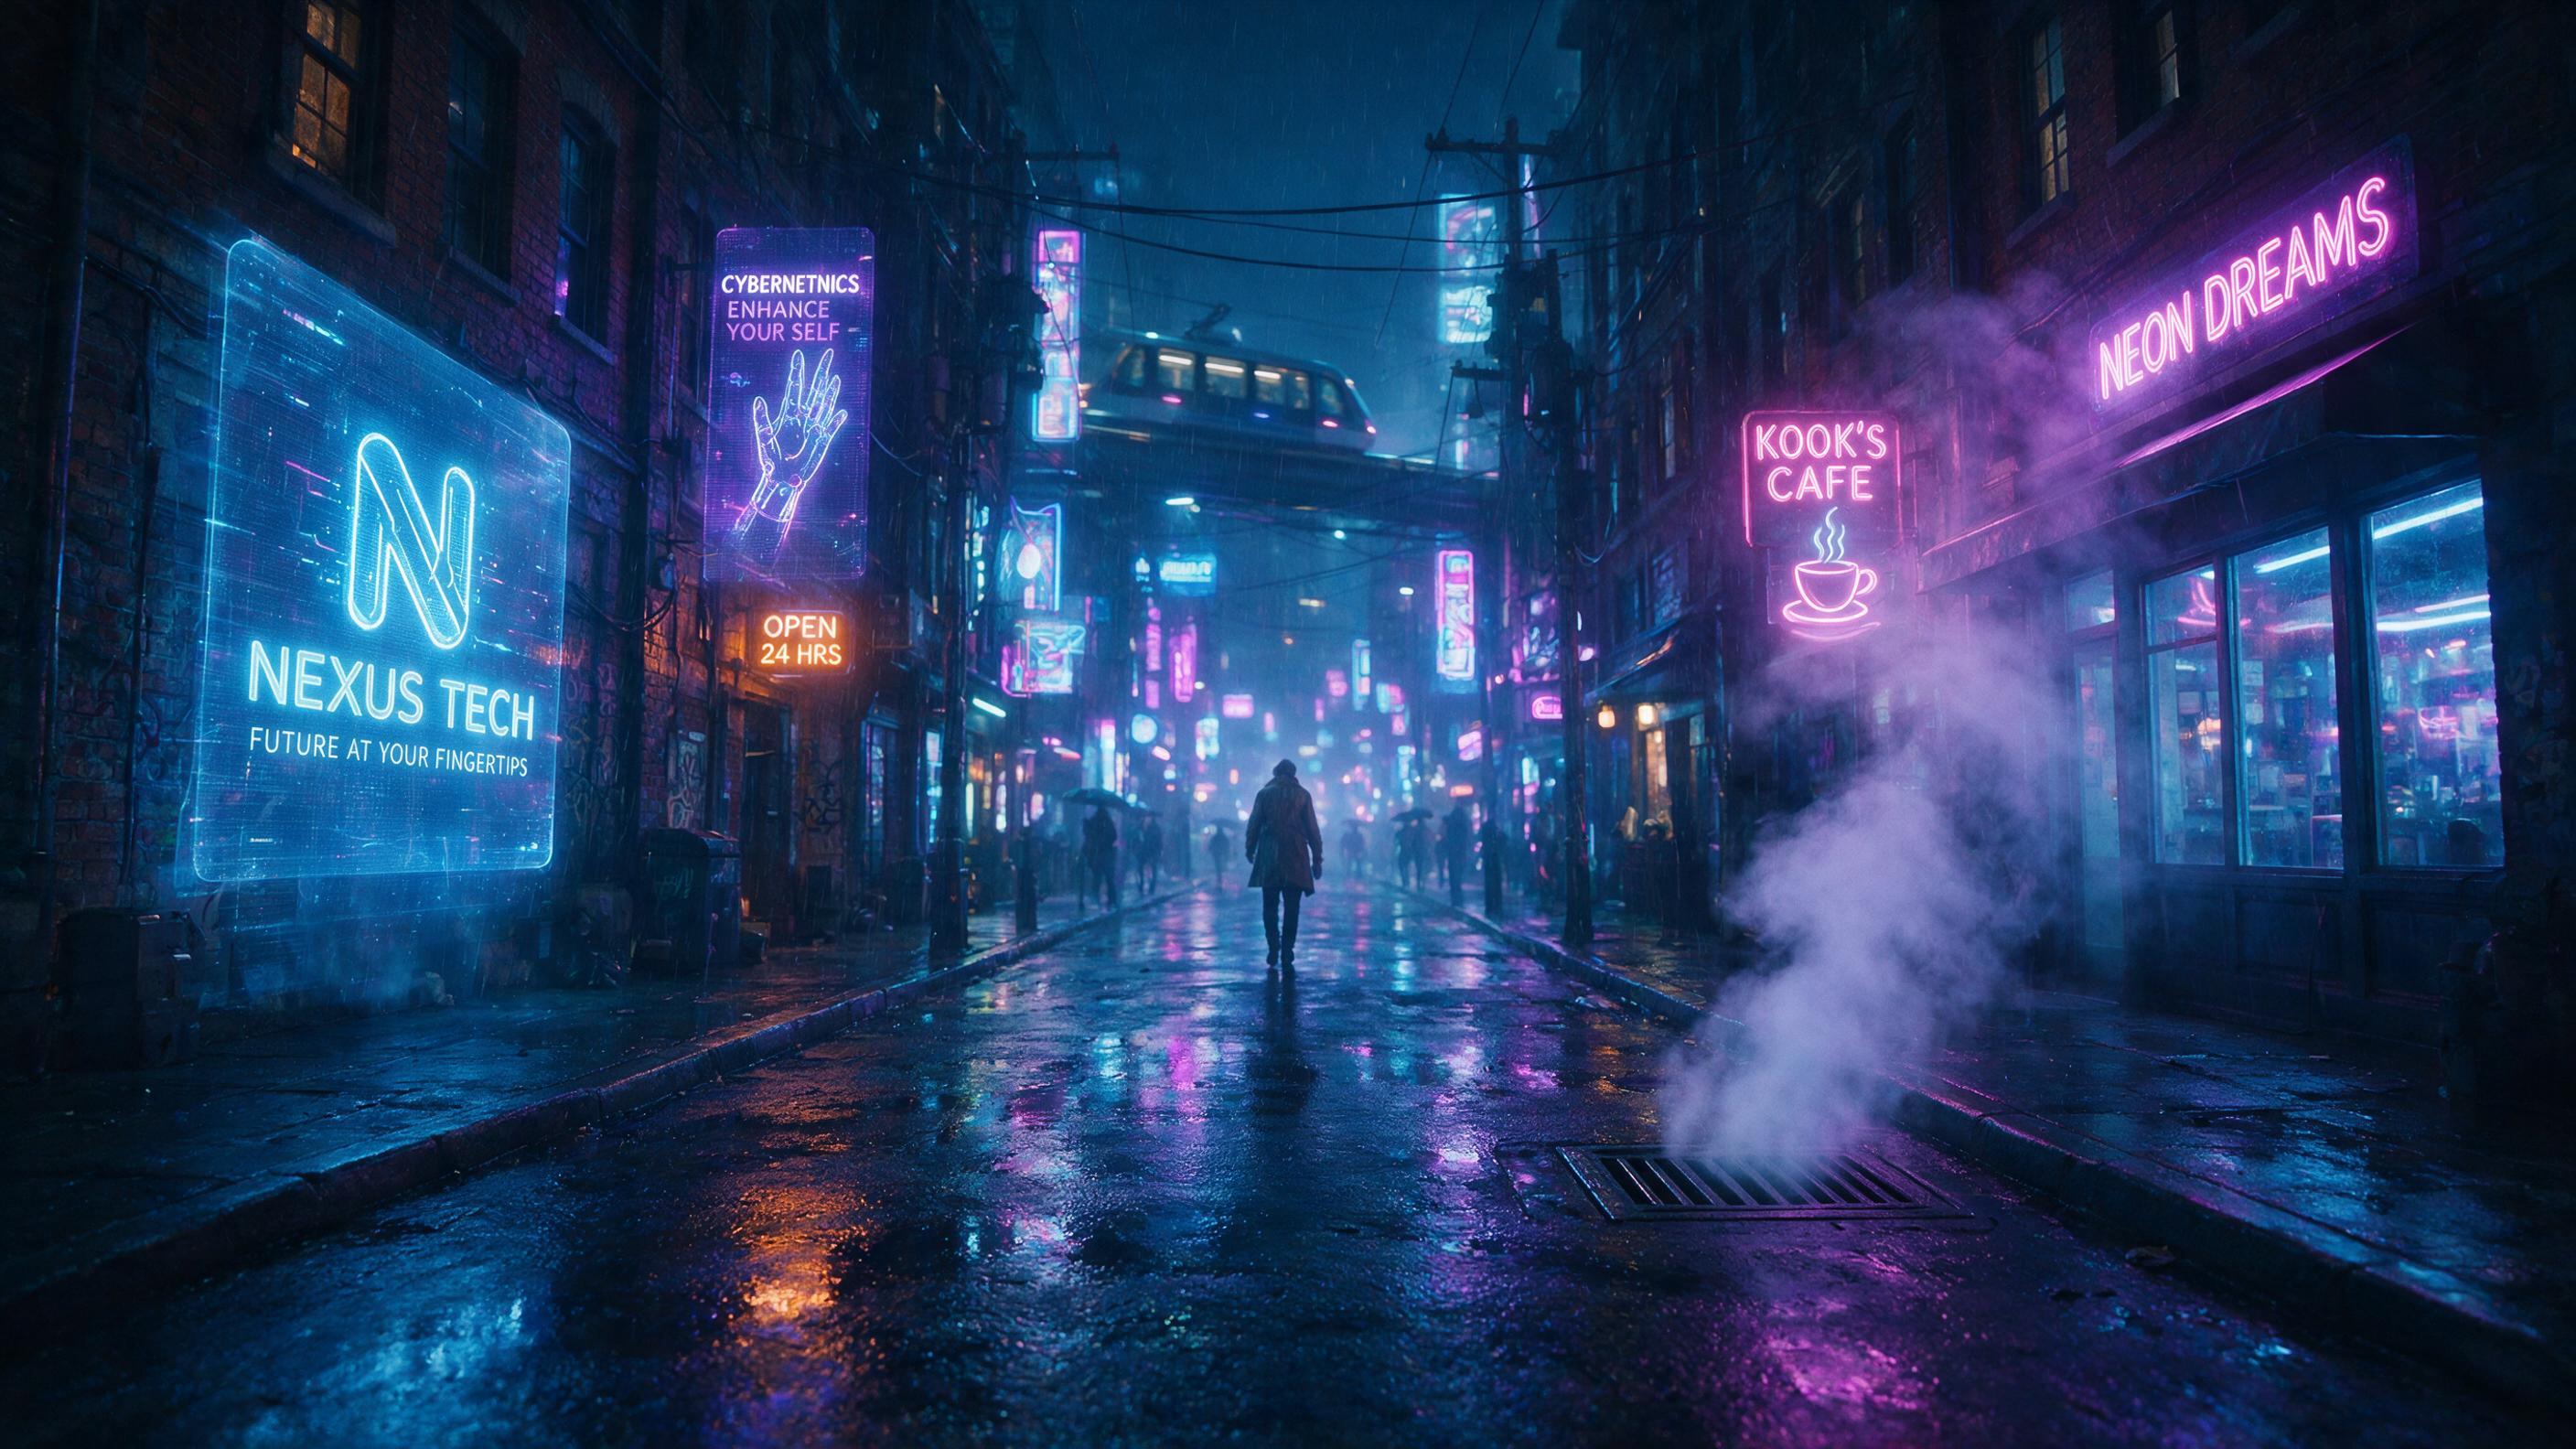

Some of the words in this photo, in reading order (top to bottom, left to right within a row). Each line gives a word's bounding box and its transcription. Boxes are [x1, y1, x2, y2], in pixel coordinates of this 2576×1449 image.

[721, 274, 860, 294] CYBERNETNICS
[2098, 290, 2194, 400] NEON
[2204, 177, 2389, 343] DREAMS
[727, 300, 831, 318] ENHANCE
[725, 322, 785, 341] YOUR
[791, 322, 840, 341] SELF
[1755, 420, 1887, 460] KOOK'S
[1766, 465, 1873, 502] CAFE
[763, 615, 837, 639] OPEN
[760, 643, 790, 664] 24
[797, 643, 843, 665] HRS
[248, 639, 424, 724] NEXUS
[439, 679, 535, 741] TECH
[249, 727, 339, 759] FUTURE
[346, 738, 372, 762] AT
[378, 741, 429, 768] YOUR
[435, 748, 528, 778] FINGERTIPS
